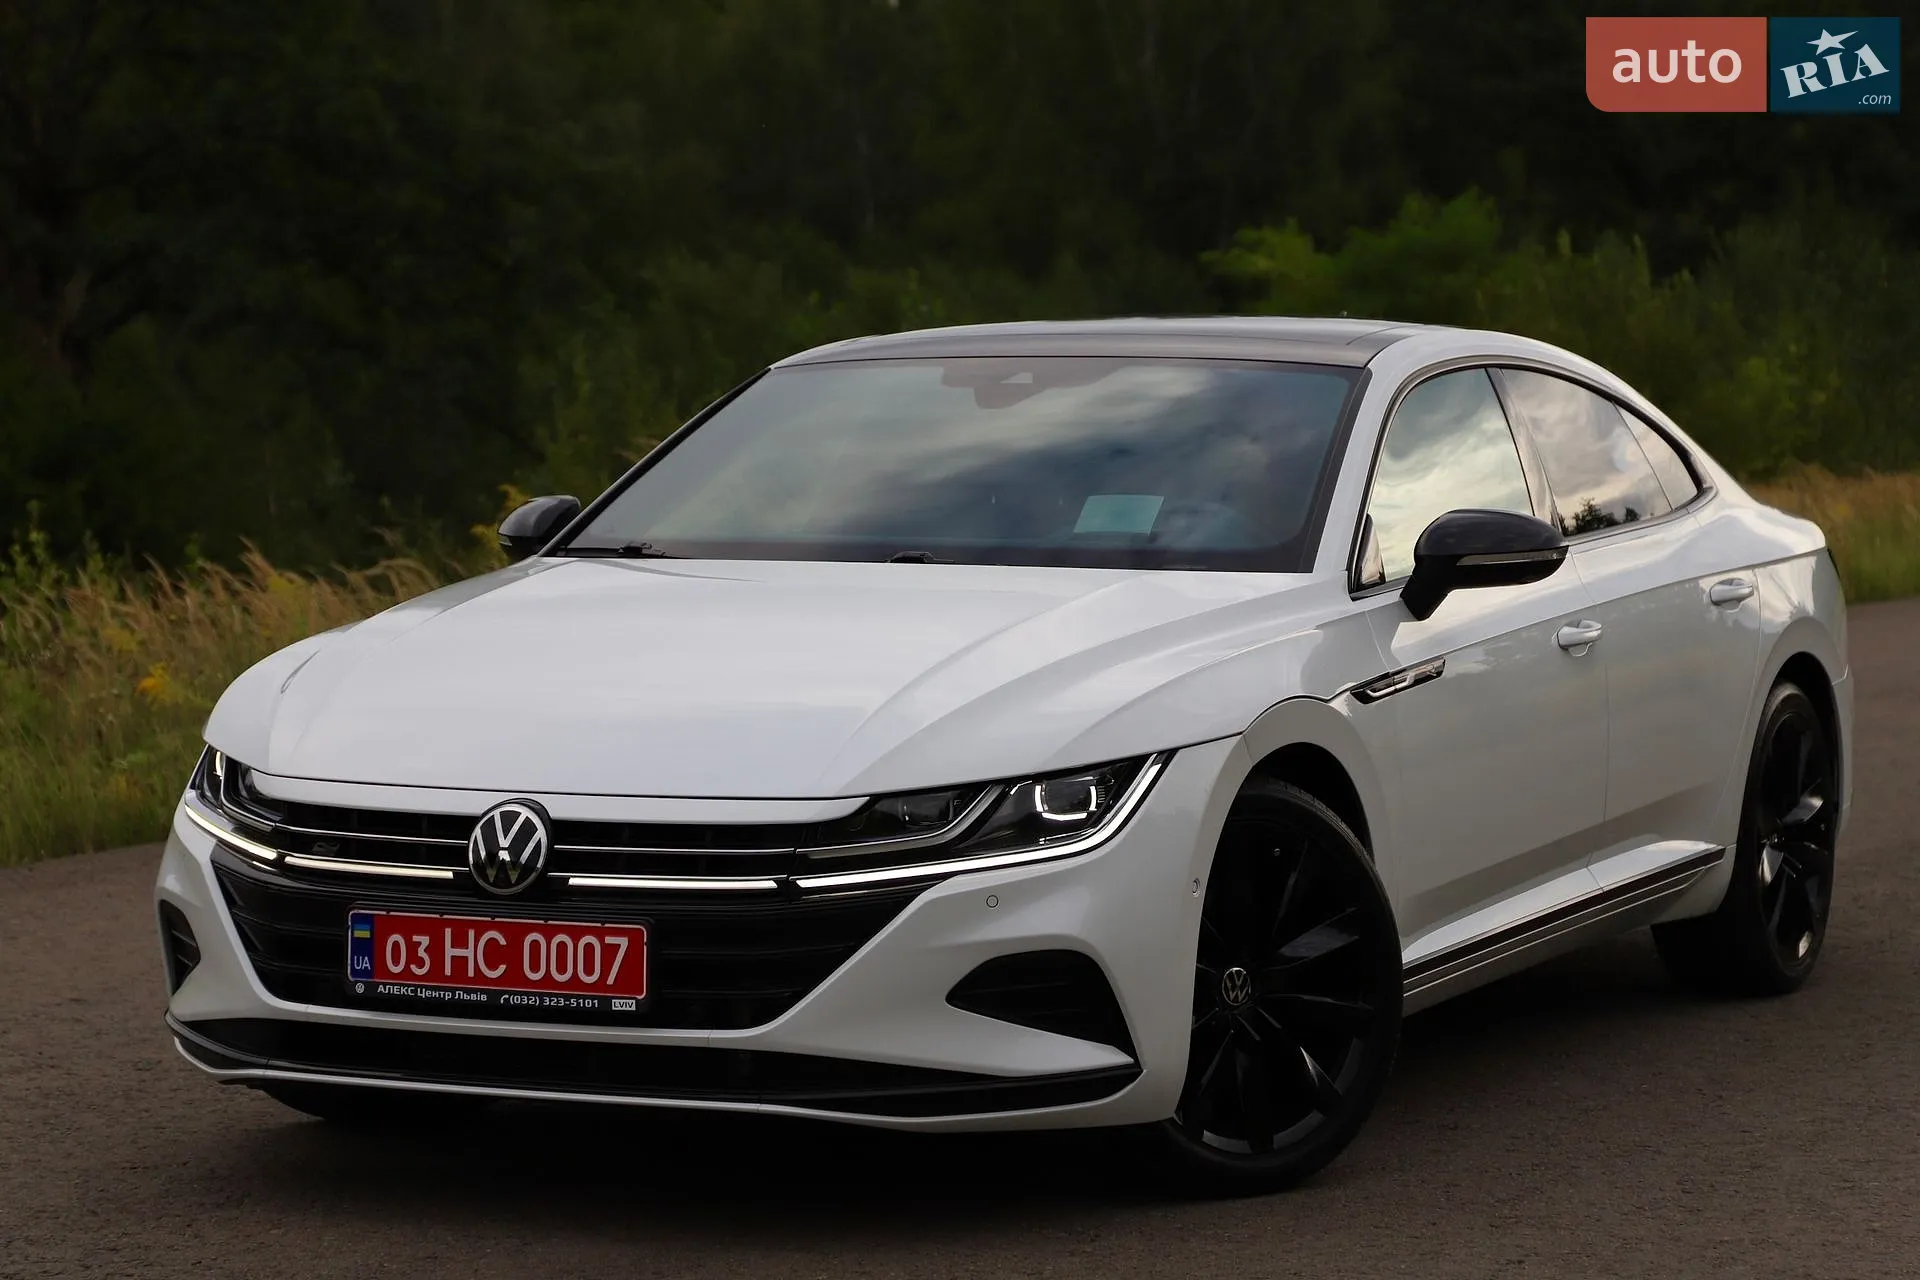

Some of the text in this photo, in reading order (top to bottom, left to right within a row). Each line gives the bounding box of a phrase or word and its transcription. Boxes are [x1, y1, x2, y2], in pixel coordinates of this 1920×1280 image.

[354, 956, 371, 970] UA
[385, 927, 629, 985] 03 HC 0007
[377, 984, 416, 996] АЛЕКС
[417, 988, 452, 1000] Центр
[454, 990, 488, 1001] Львів
[509, 995, 599, 1008] (032) 323-5101
[613, 1001, 634, 1009] LVIV
